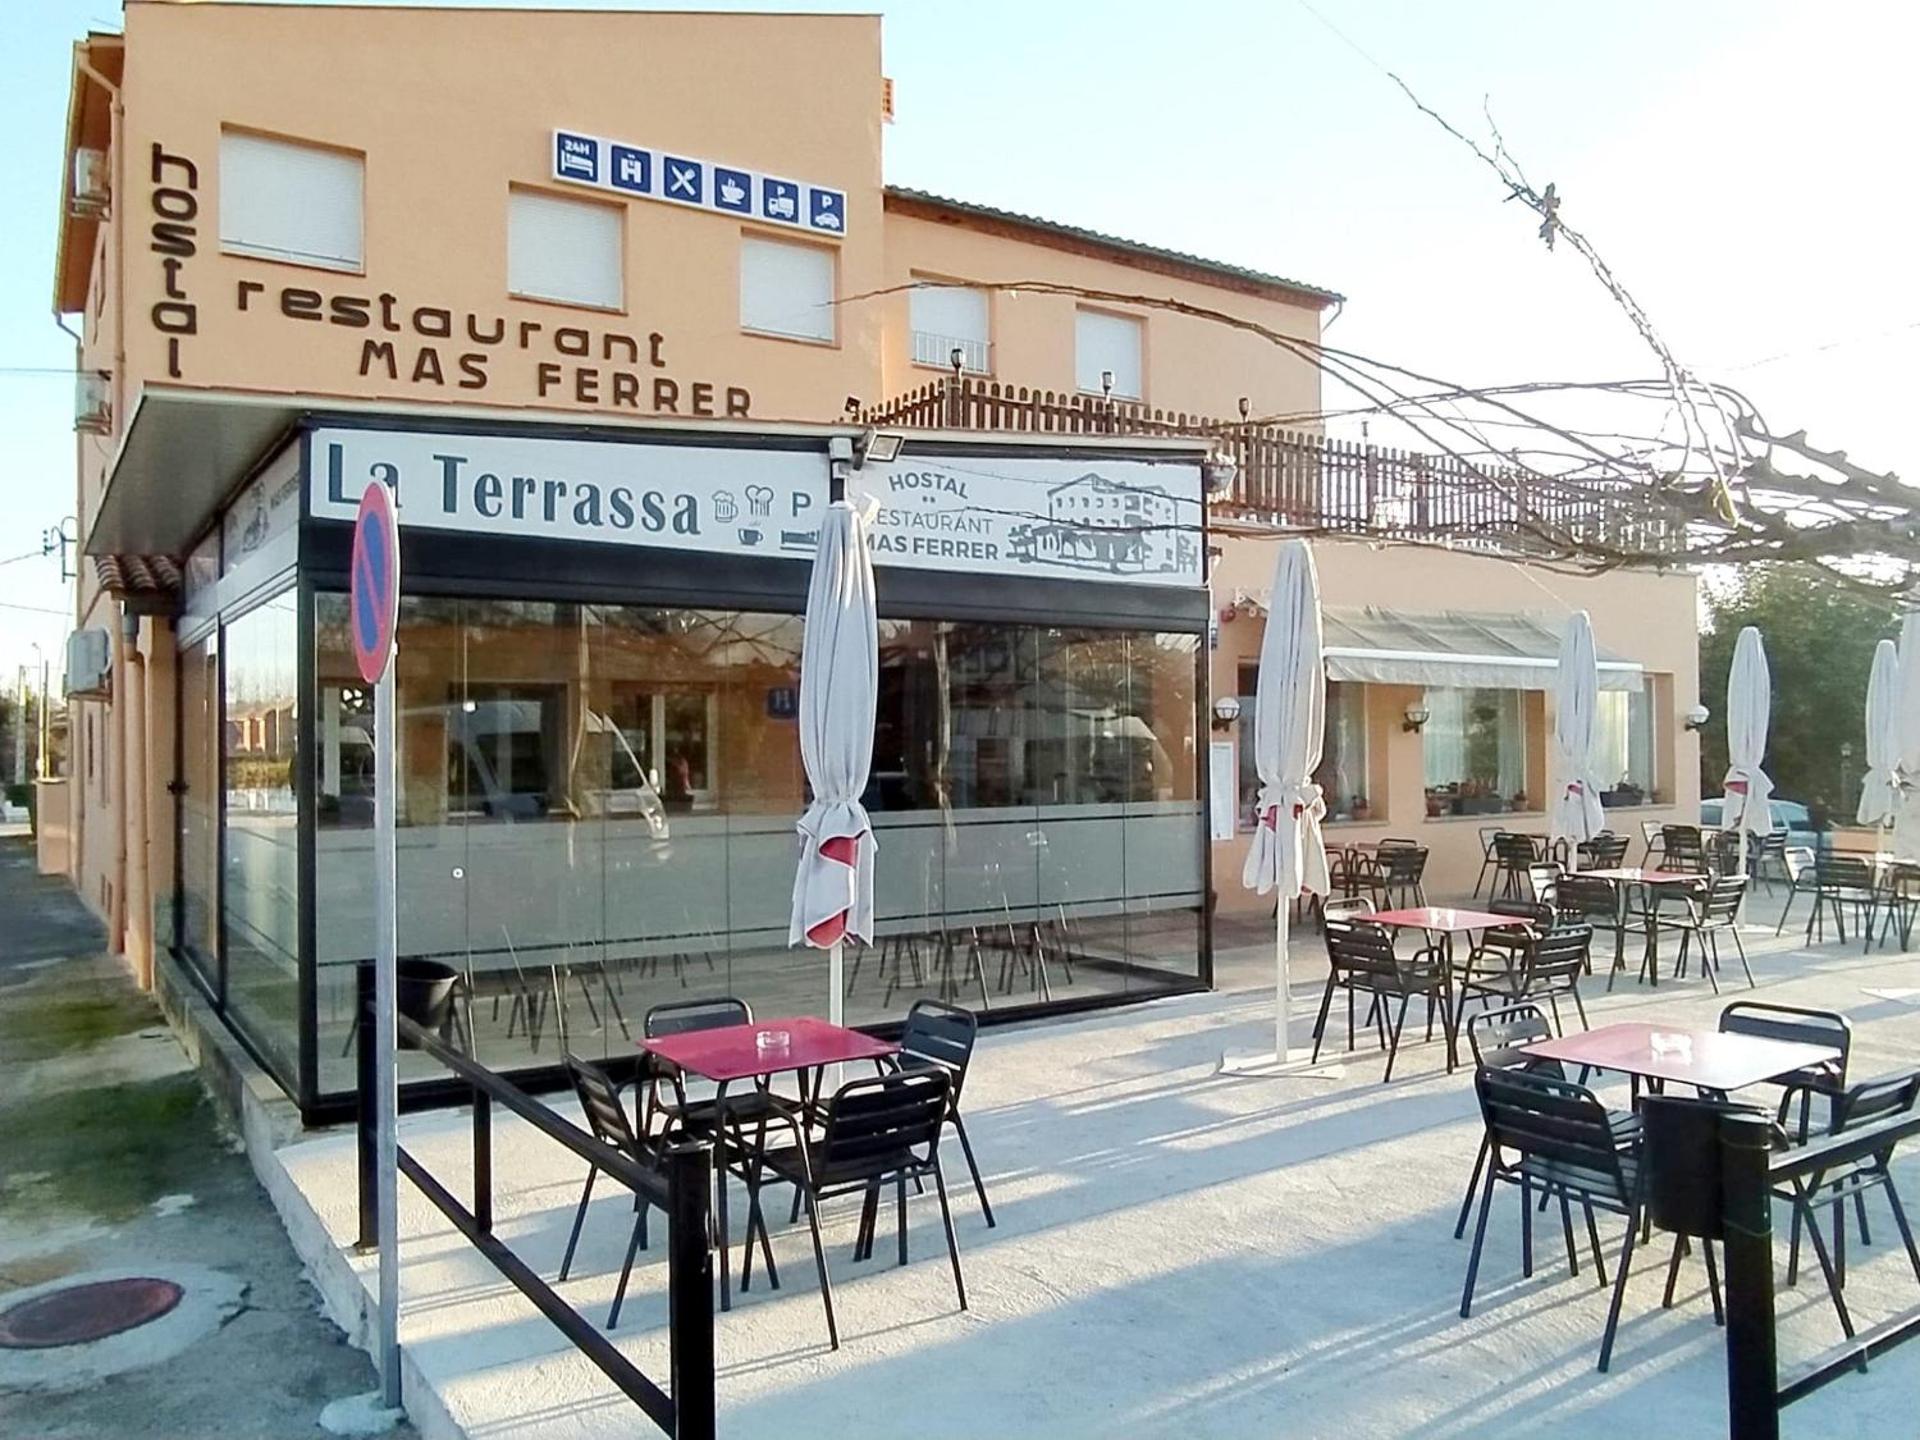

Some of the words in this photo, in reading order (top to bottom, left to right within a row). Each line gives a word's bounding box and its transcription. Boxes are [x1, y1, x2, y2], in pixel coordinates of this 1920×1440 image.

[564, 140, 590, 155] 24H
[777, 186, 785, 197] P
[822, 195, 833, 208] P
[152, 142, 197, 378] hostal
[237, 279, 666, 368] restaurant
[359, 339, 488, 389] MAS
[538, 363, 751, 418] FERRER
[328, 443, 403, 508] La
[433, 454, 701, 536] Terrassa
[792, 491, 811, 517] P
[871, 508, 994, 534] ESTAURANT
[888, 472, 969, 500] HOSTAL
[912, 536, 999, 560] FERRER
